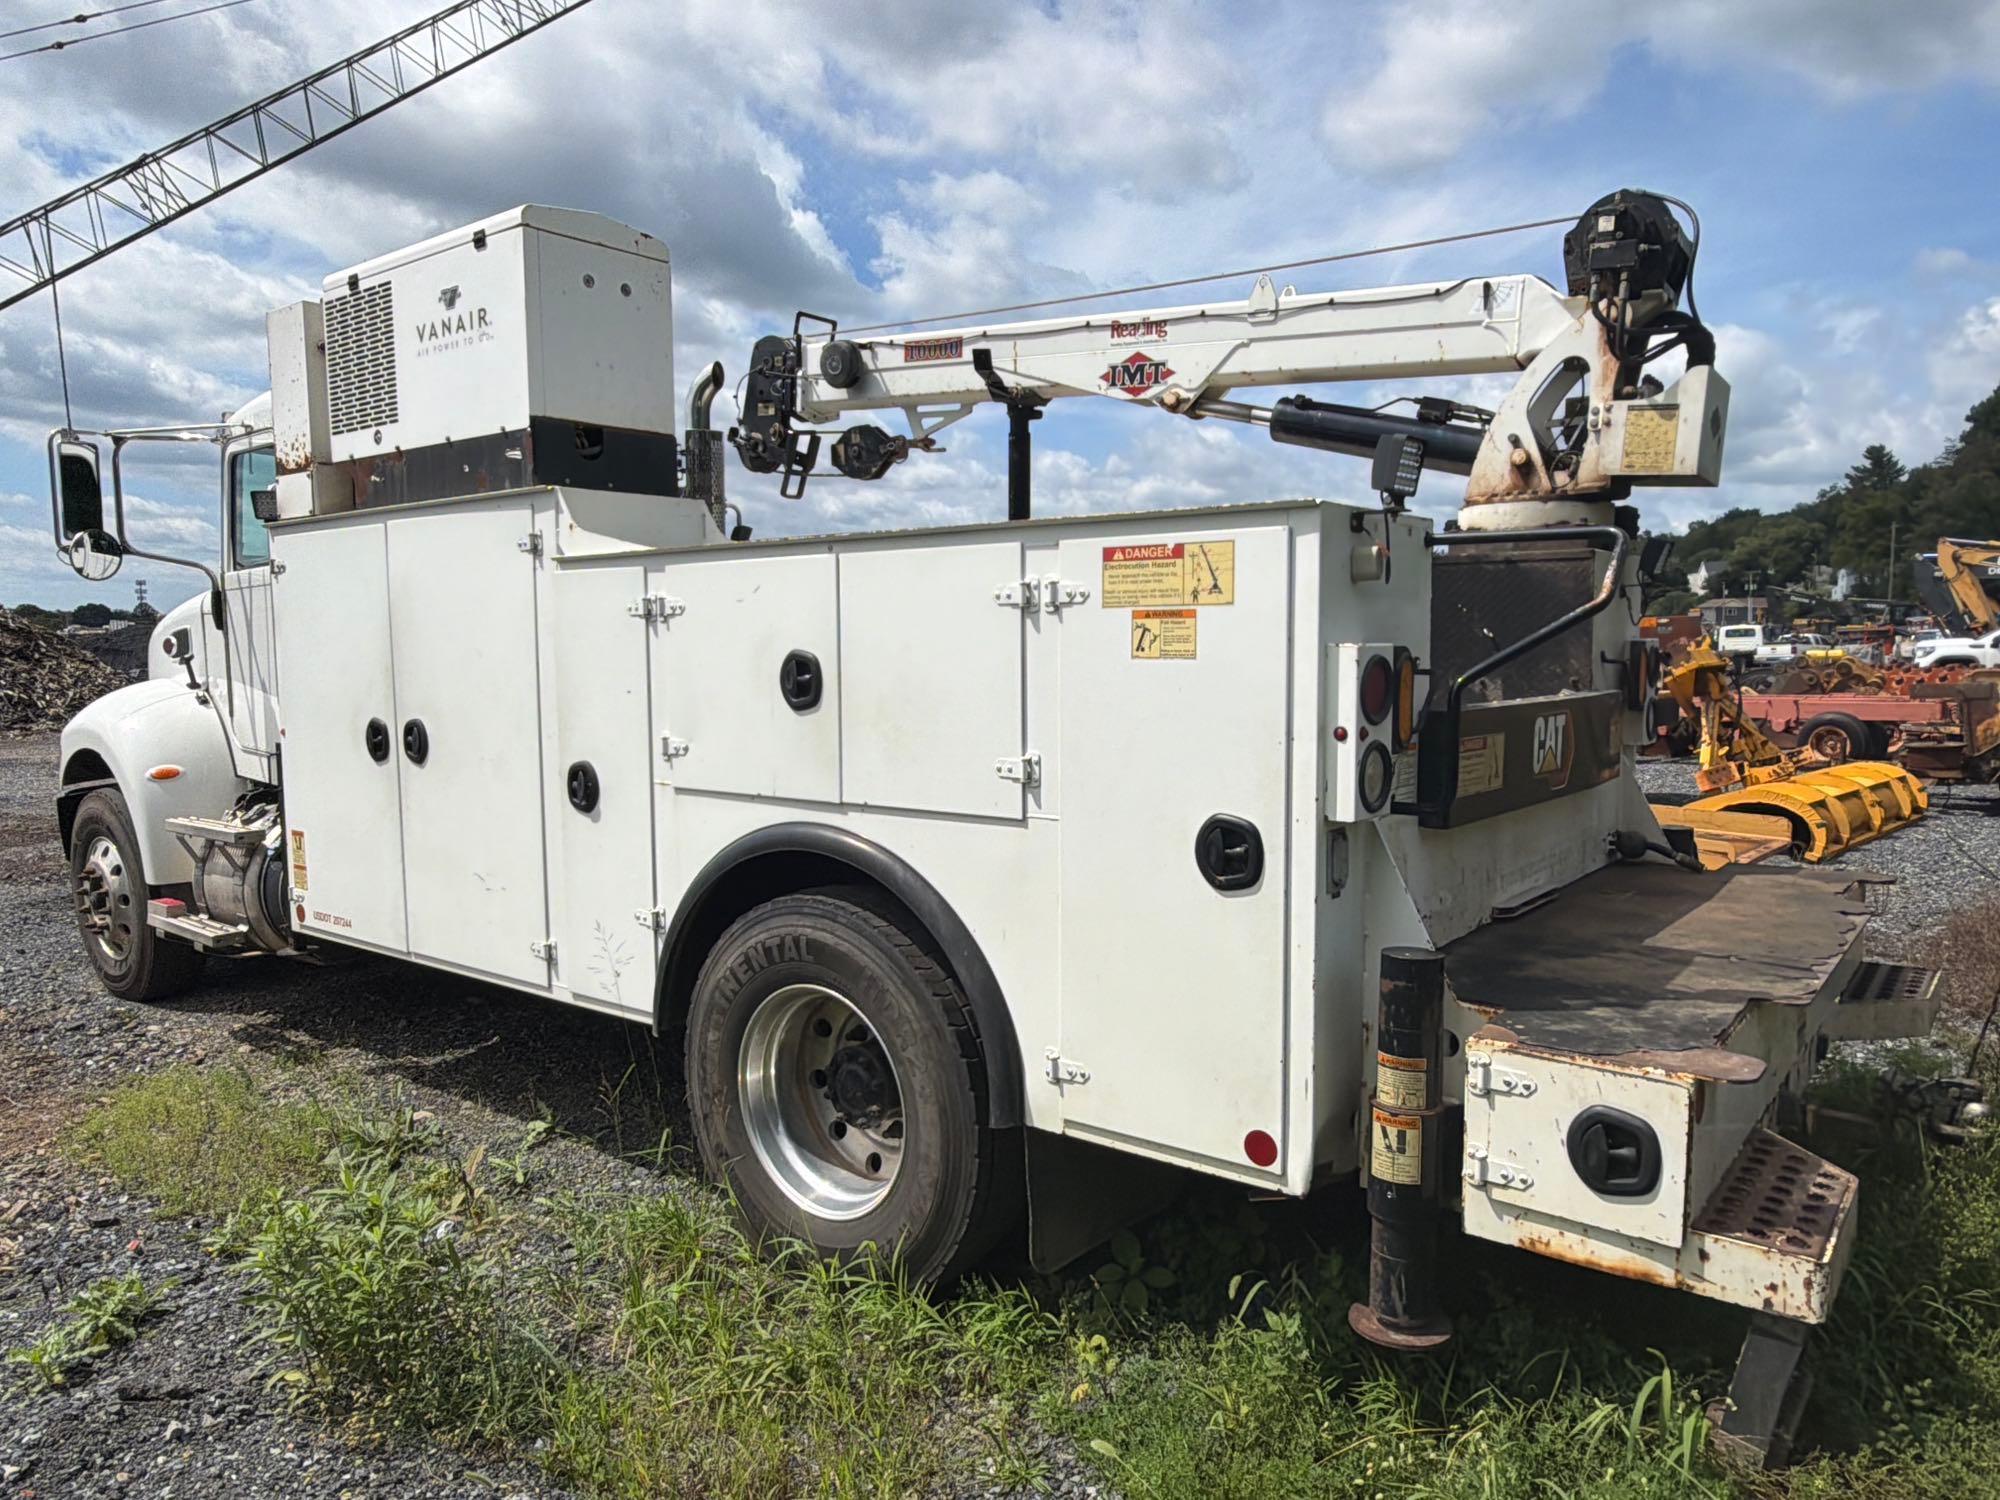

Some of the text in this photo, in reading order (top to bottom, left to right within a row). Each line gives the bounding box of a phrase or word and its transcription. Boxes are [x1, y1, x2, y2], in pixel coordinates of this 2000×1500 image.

[416, 307, 489, 343] VANAIR
[1108, 361, 1168, 388] IMT
[1125, 547, 1173, 559] DANGER
[1151, 560, 1177, 569] Hazard
[1533, 714, 1566, 775] CAT
[1382, 1116, 1417, 1127] WARNING
